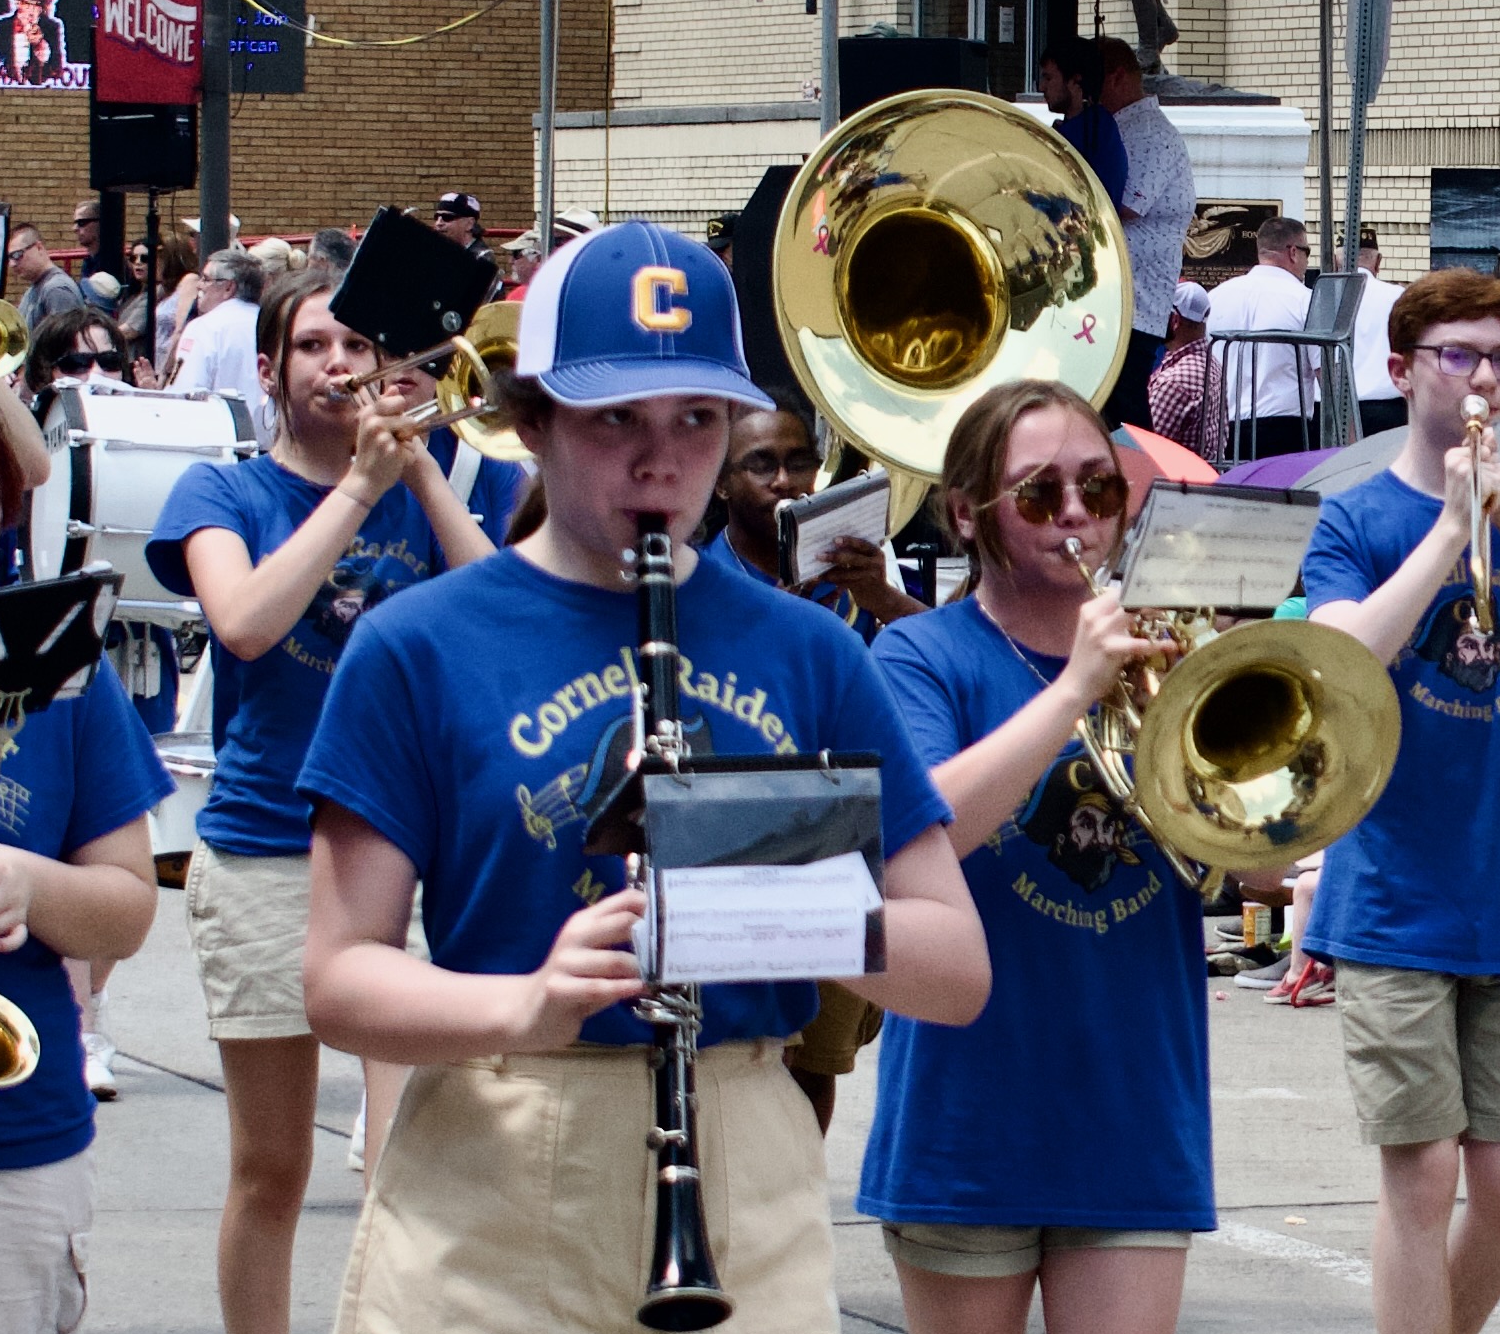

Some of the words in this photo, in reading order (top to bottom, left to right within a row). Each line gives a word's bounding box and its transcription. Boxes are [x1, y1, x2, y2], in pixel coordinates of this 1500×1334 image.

[631, 266, 692, 332] C
[281, 636, 336, 674] March
[510, 646, 640, 757] Cornel
[1409, 676, 1493, 722] Marching
[1012, 871, 1109, 934] Marching
[1111, 870, 1163, 923] Band
